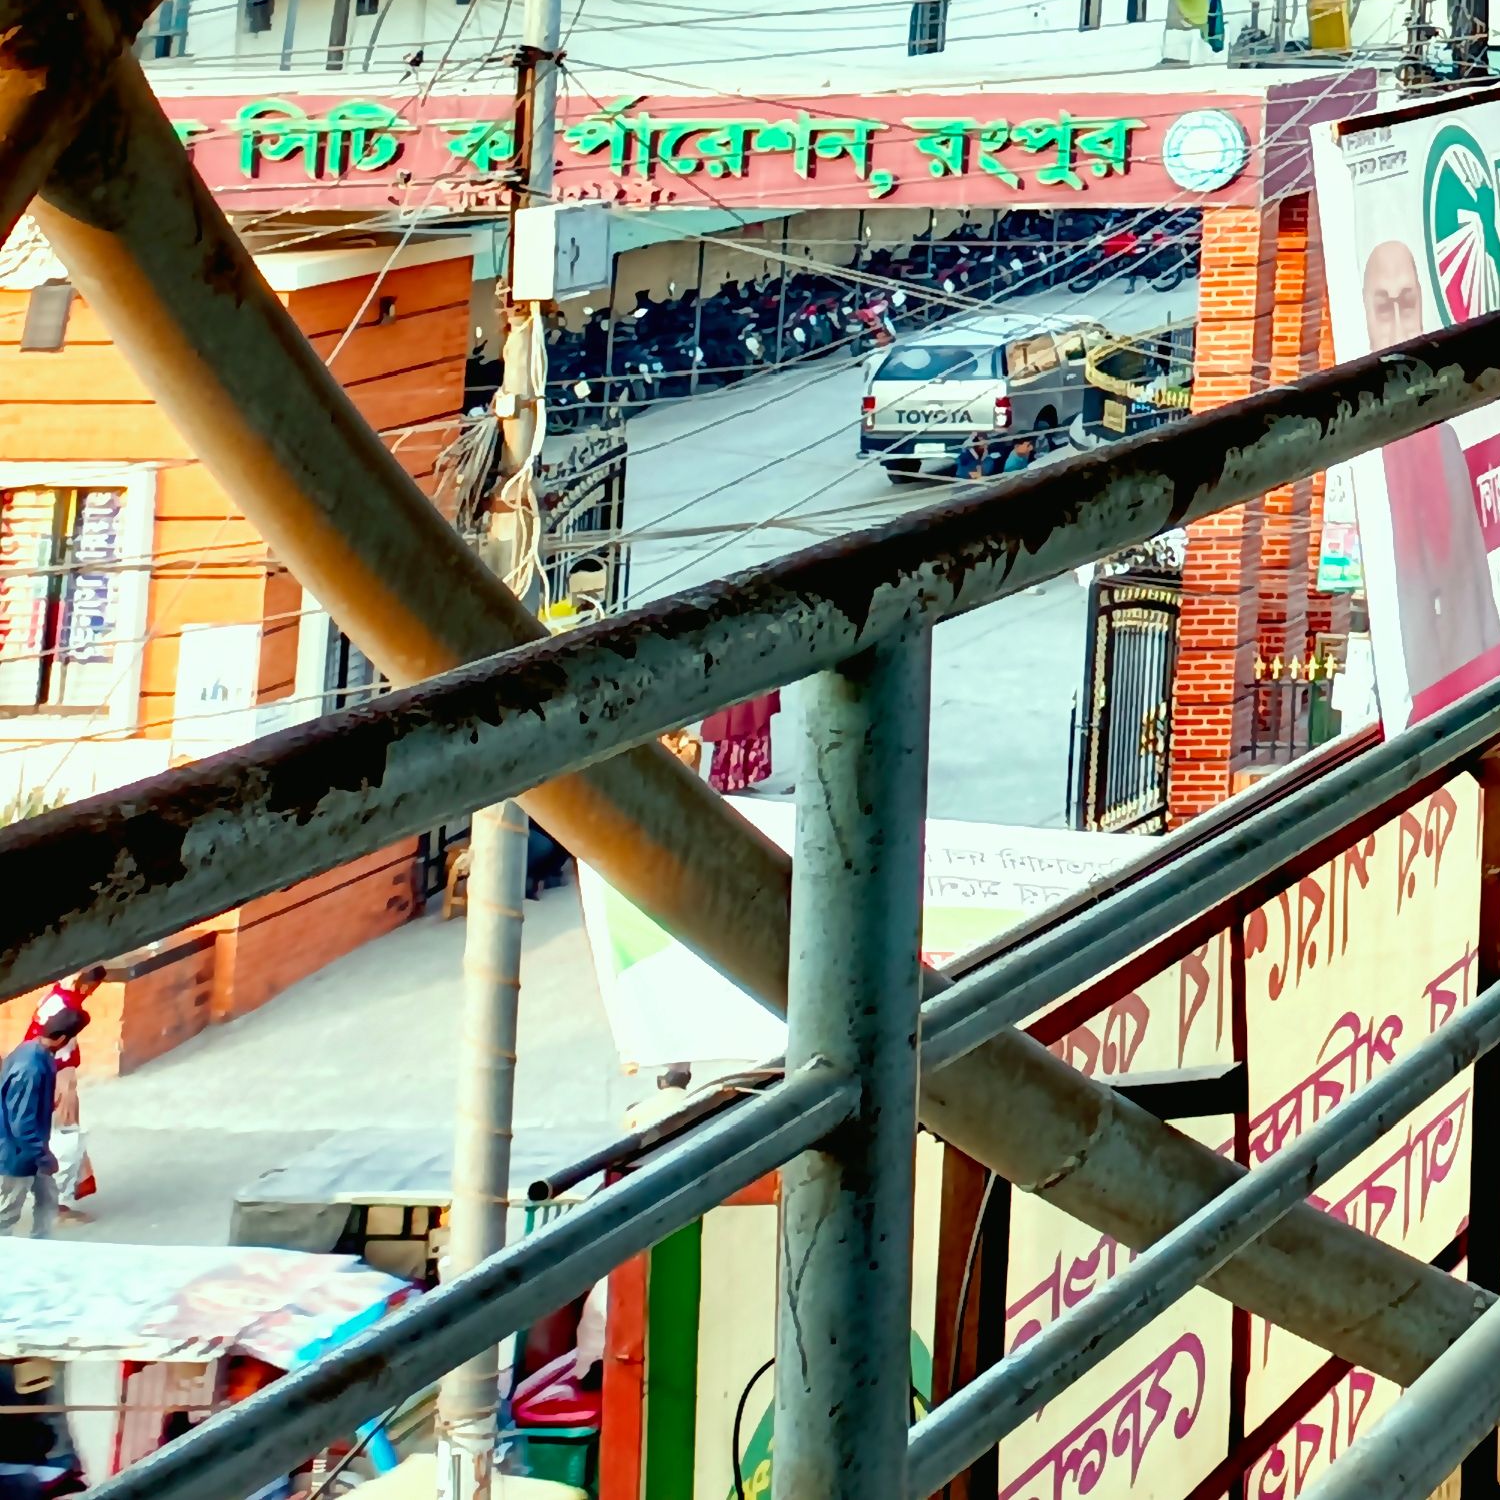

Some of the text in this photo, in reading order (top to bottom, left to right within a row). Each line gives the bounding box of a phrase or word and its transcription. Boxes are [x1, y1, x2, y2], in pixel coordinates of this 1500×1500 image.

[222, 98, 418, 181] সিটি
[902, 109, 1148, 192] রংপুর
[895, 408, 973, 426] TOYOTA
